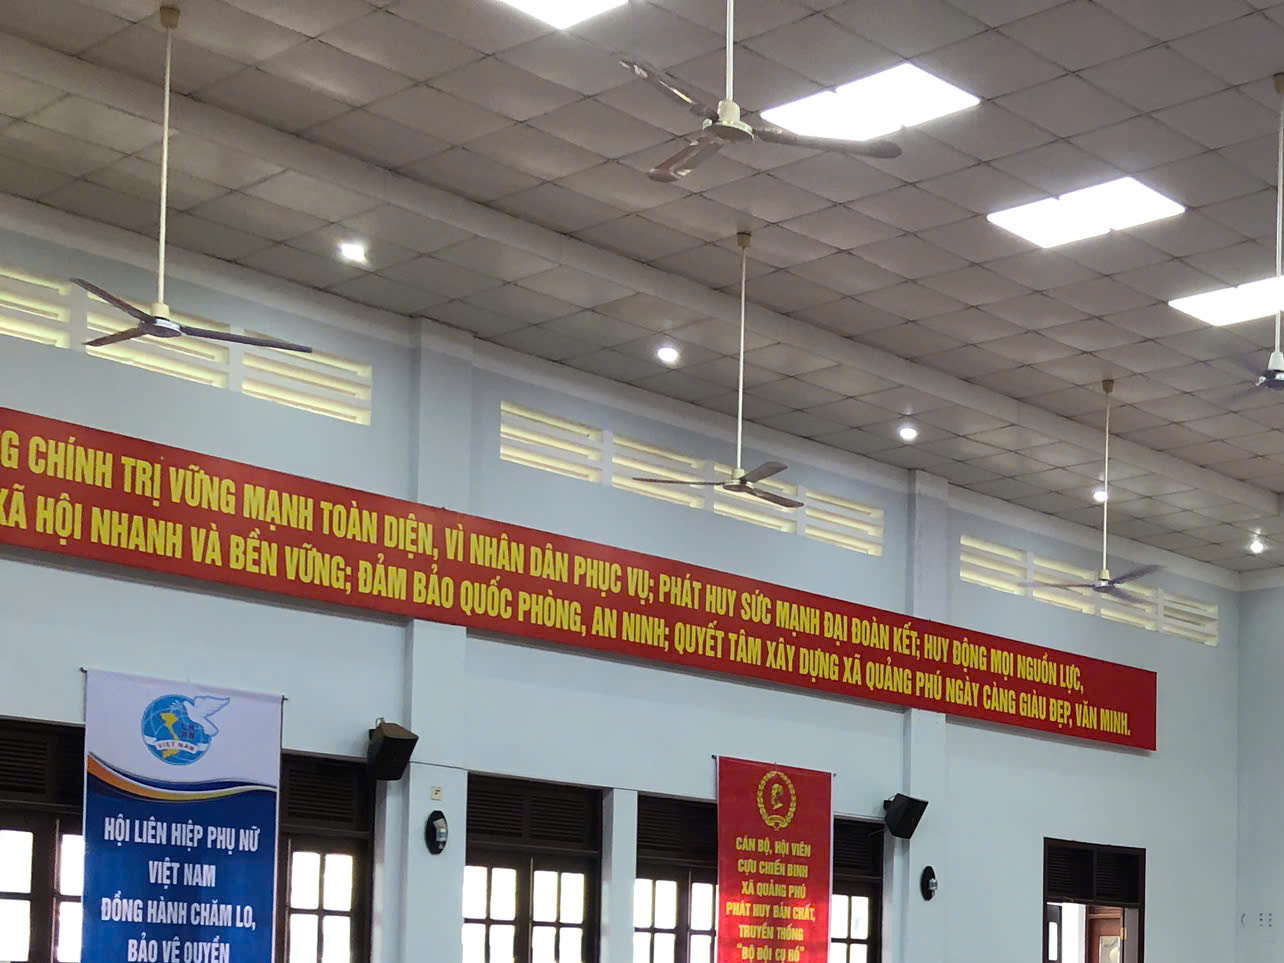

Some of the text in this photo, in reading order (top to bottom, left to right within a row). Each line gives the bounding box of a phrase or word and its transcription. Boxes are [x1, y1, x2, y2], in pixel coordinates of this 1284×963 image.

[28, 435, 113, 489] CHÍNH
[121, 456, 161, 507] TRỊ
[169, 464, 236, 515] VỮNG
[243, 483, 313, 532] MẠNH
[320, 500, 377, 543] TOÀN
[384, 513, 439, 560] DIỆN,
[445, 524, 464, 562] VÌ
[470, 532, 524, 574] NHÂN
[530, 542, 569, 582] DÂN
[574, 555, 622, 598] PHỤC
[627, 566, 654, 604] VỤ;
[659, 572, 702, 612] PHÁT
[705, 583, 737, 617] HUY
[741, 589, 772, 625] SỨC
[776, 600, 820, 638] MẠNH
[824, 612, 848, 647] ĐẠI
[852, 616, 890, 652] ĐOÀN
[893, 621, 920, 660] KẾT;
[924, 634, 949, 661] HUY
[953, 636, 987, 674] ĐỘNG
[990, 649, 1014, 682] MỌI
[1017, 652, 1057, 687] NGUỒN
[1060, 668, 1084, 694] LỰC,
[36, 493, 82, 545] HỘI
[91, 507, 183, 559] NHANH
[191, 523, 222, 567] VÀ
[229, 526, 277, 578] BỀN
[285, 543, 352, 595] VỮNG;
[358, 553, 407, 600] ĐẢM
[413, 564, 453, 608] BẢO
[460, 571, 512, 620] QUỐC
[518, 589, 586, 637] PHÒNG,
[591, 606, 617, 639] AN
[622, 611, 669, 651] NINH;
[674, 619, 723, 659] QUYẾT
[728, 628, 762, 663] TÂM
[766, 636, 796, 673] XÂY
[799, 647, 839, 683] DỰNG
[842, 656, 862, 686] XÃ
[865, 656, 912, 695] QUẢNG
[916, 671, 942, 702] PHÚ
[945, 674, 979, 706] NGÀY
[983, 679, 1016, 715] CÀNG
[1020, 688, 1046, 720] GIÀU
[1049, 698, 1072, 729] ĐẸP,
[1075, 700, 1097, 730] VĂN
[1100, 708, 1131, 736] MINH.
[104, 813, 260, 854] HỘI LIÊN HIỆP PHỤ NỮ
[736, 835, 756, 851] CÁN
[775, 839, 789, 857] HỘI
[791, 841, 811, 857] VIÊN
[149, 860, 216, 889] VIỆT NAM
[759, 859, 785, 876] CHIẾN
[787, 863, 808, 878] BINH
[741, 879, 806, 899] XÃ QUẢNG PHÚ
[100, 890, 256, 932] ĐỒNG HÀNH CHĂM LO,
[726, 900, 751, 917] PHÁT
[753, 904, 770, 918] HUY
[773, 901, 791, 919] BẢN
[777, 923, 804, 941] THỐNG
[128, 932, 158, 963] BẢO
